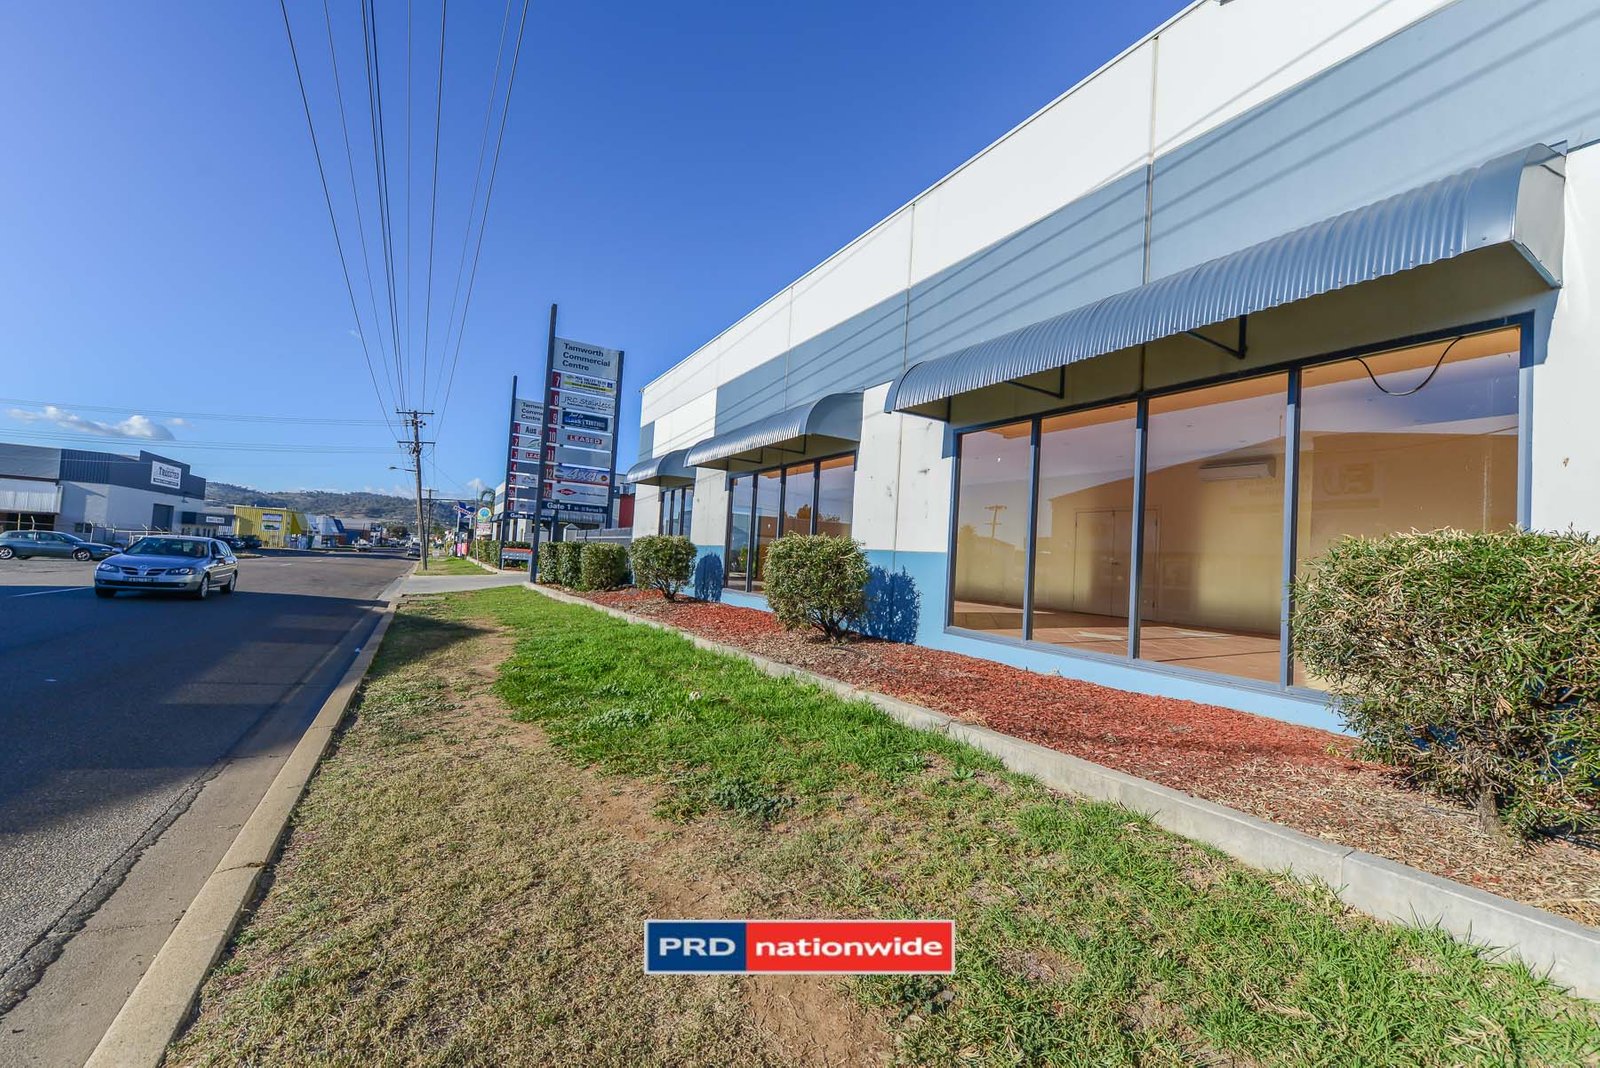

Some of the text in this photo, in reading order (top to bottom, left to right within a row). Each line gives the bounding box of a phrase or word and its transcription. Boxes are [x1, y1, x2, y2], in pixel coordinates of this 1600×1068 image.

[563, 342, 604, 357] Tamworth
[562, 351, 611, 367] Commercial
[562, 360, 590, 371] Centre
[556, 376, 561, 387] 7
[521, 401, 543, 410] Tamwo
[554, 395, 559, 405] 8
[521, 408, 543, 416] Comme
[521, 413, 541, 421] Centre
[549, 431, 556, 442] 10
[569, 435, 601, 444] LEASED
[548, 450, 554, 461] 11
[546, 468, 552, 479] 12
[546, 502, 565, 510] Gate
